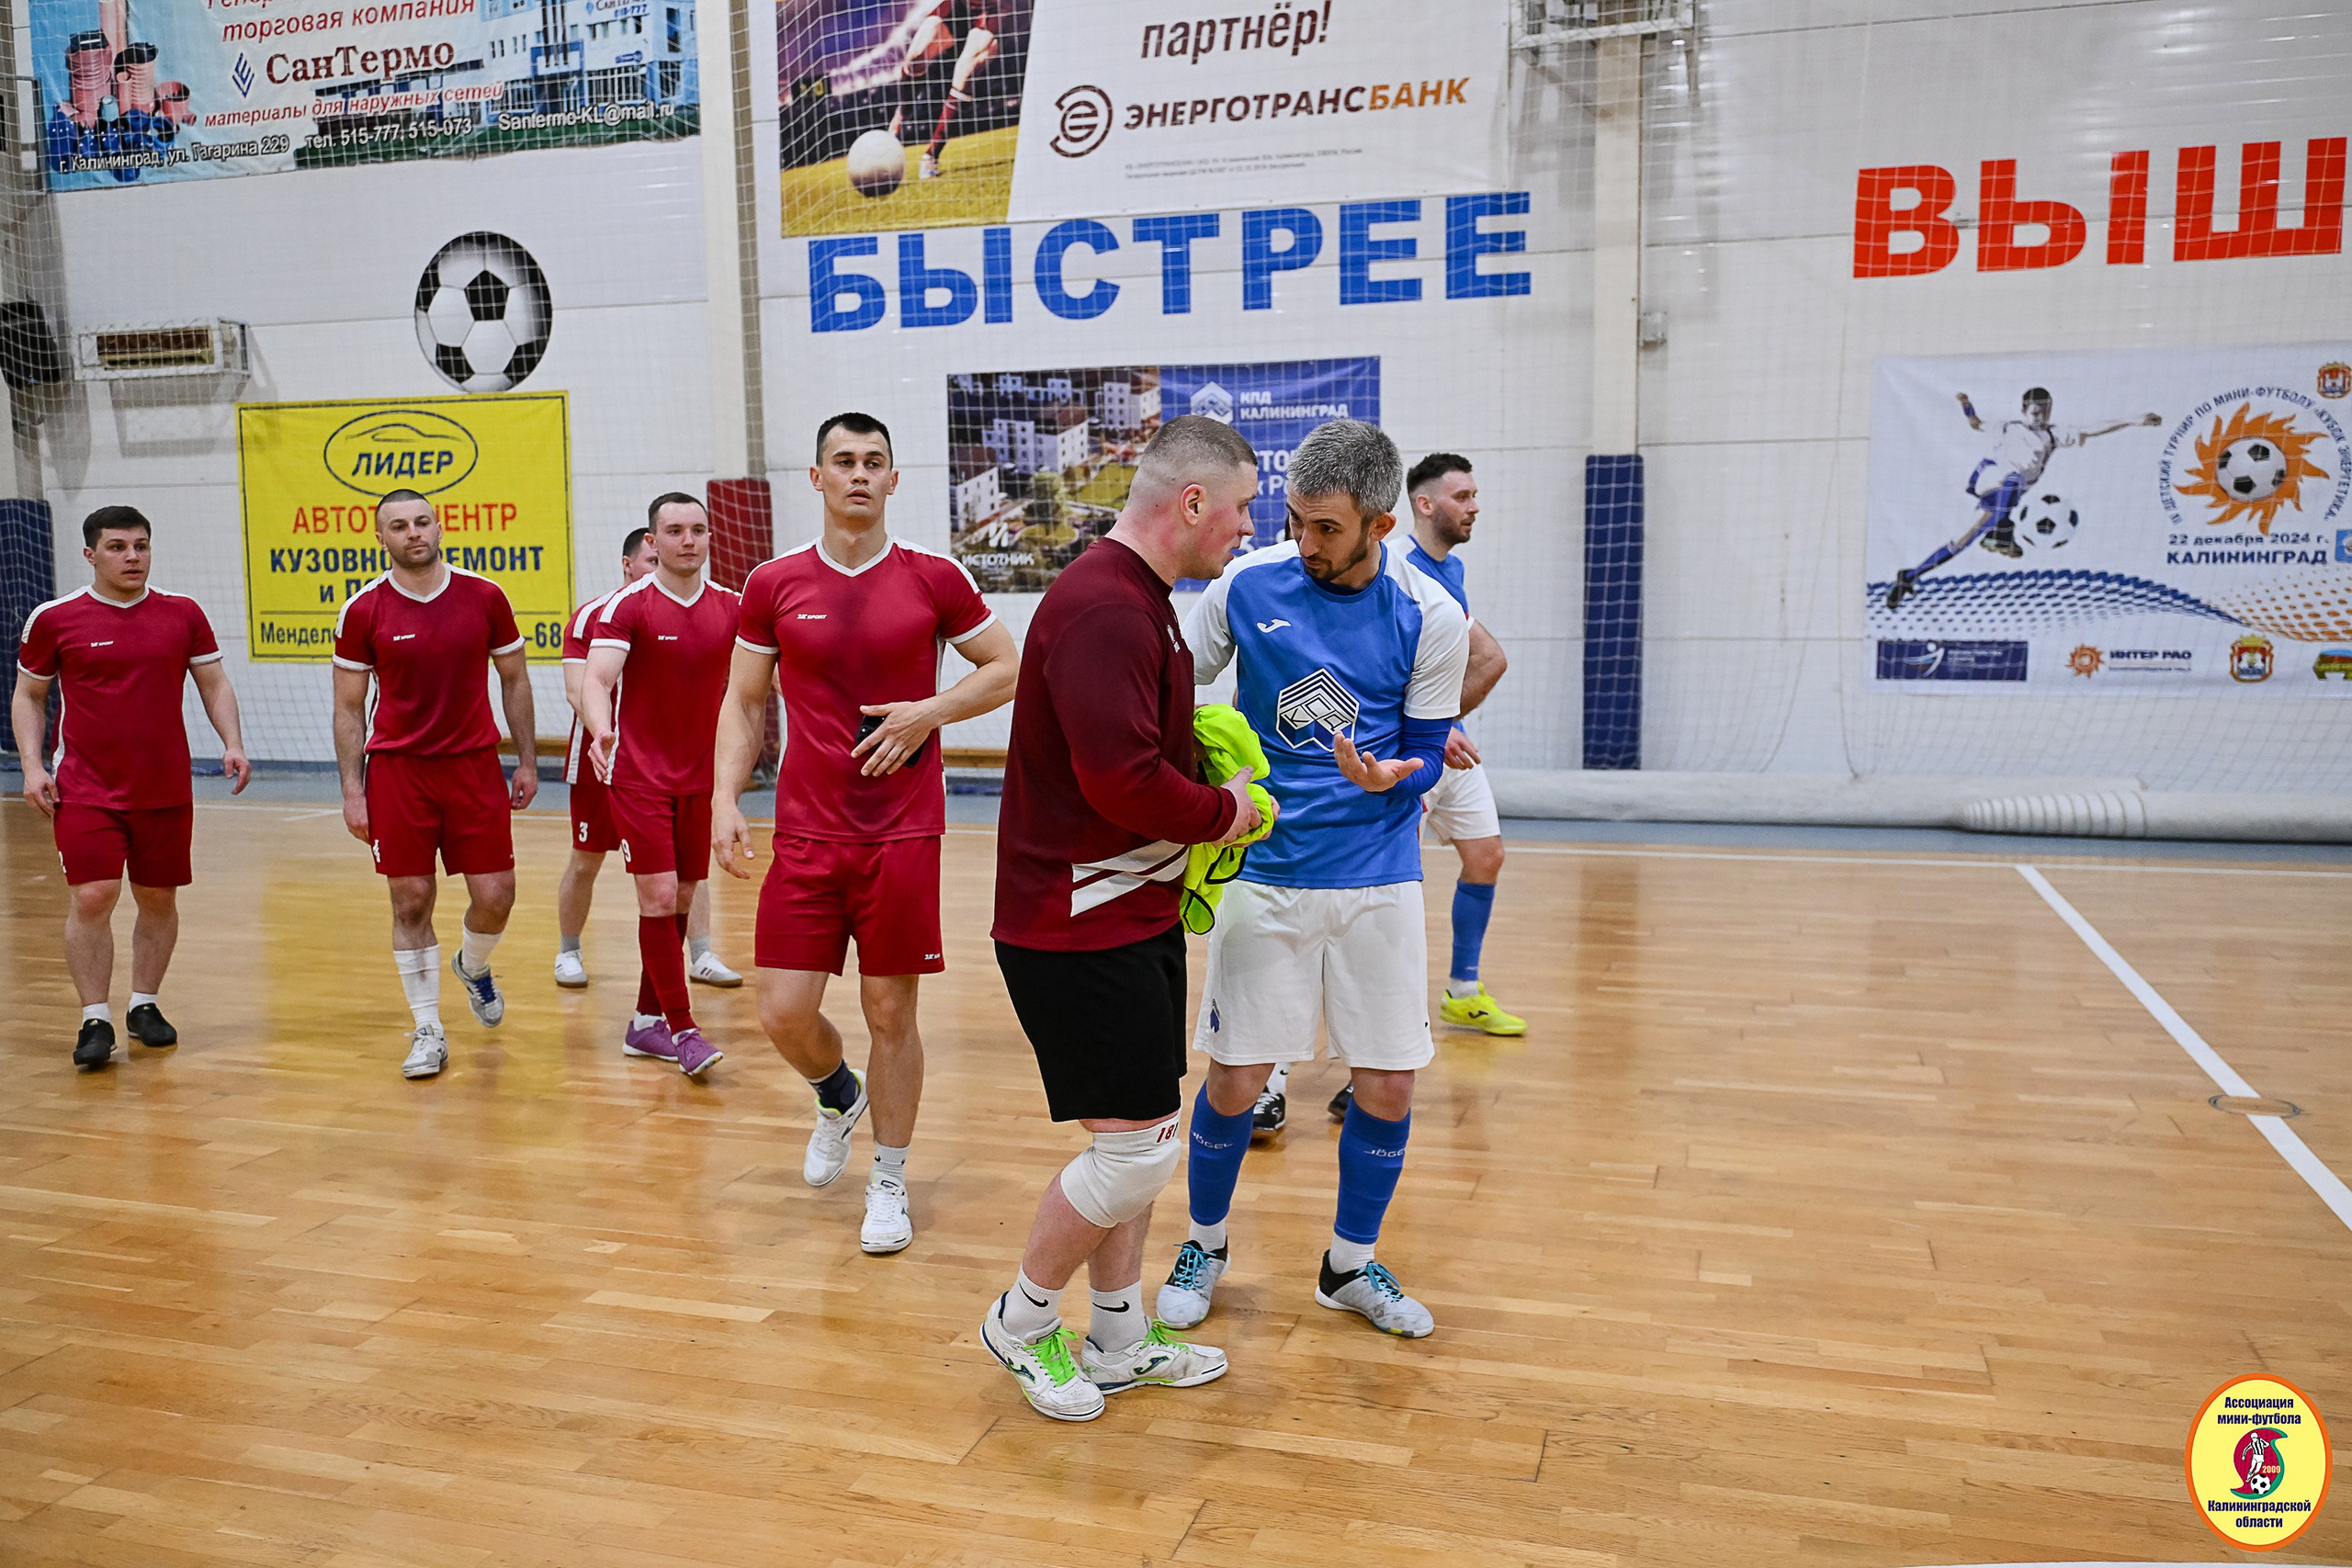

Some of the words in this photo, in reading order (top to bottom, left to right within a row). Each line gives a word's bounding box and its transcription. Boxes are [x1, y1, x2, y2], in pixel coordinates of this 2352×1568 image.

[222, 11, 344, 43] торговая
[352, 0, 475, 27] компания
[1141, 1, 1331, 64] партнёр!
[266, 42, 455, 85] СанТермо
[205, 104, 307, 127] материалы
[312, 99, 343, 116] для
[349, 90, 441, 113] наружных
[445, 80, 504, 101] сетей
[1124, 77, 1470, 130] ЭНЕРГОТРАНСБАНК
[305, 135, 336, 148] тел.
[408, 118, 473, 139] 515-073
[168, 148, 190, 165] ул.
[191, 141, 258, 161] Гагарина
[261, 135, 290, 154] 229
[1853, 137, 2347, 277] ВЫШ
[809, 191, 1531, 333] БЫСТРЕЕ
[1240, 390, 1272, 405] КПД
[1240, 404, 1349, 420] КАЛИНИНГРАД
[2194, 401, 2212, 418] ПО
[351, 450, 454, 479] ЛИДЕР
[2193, 533, 2264, 547] декабря
[2270, 533, 2311, 544] 2024
[2166, 550, 2328, 565] КАЛИНИНГРАД
[261, 622, 336, 647] Мендел
[579, 821, 588, 842] 3
[621, 839, 631, 863] 9
